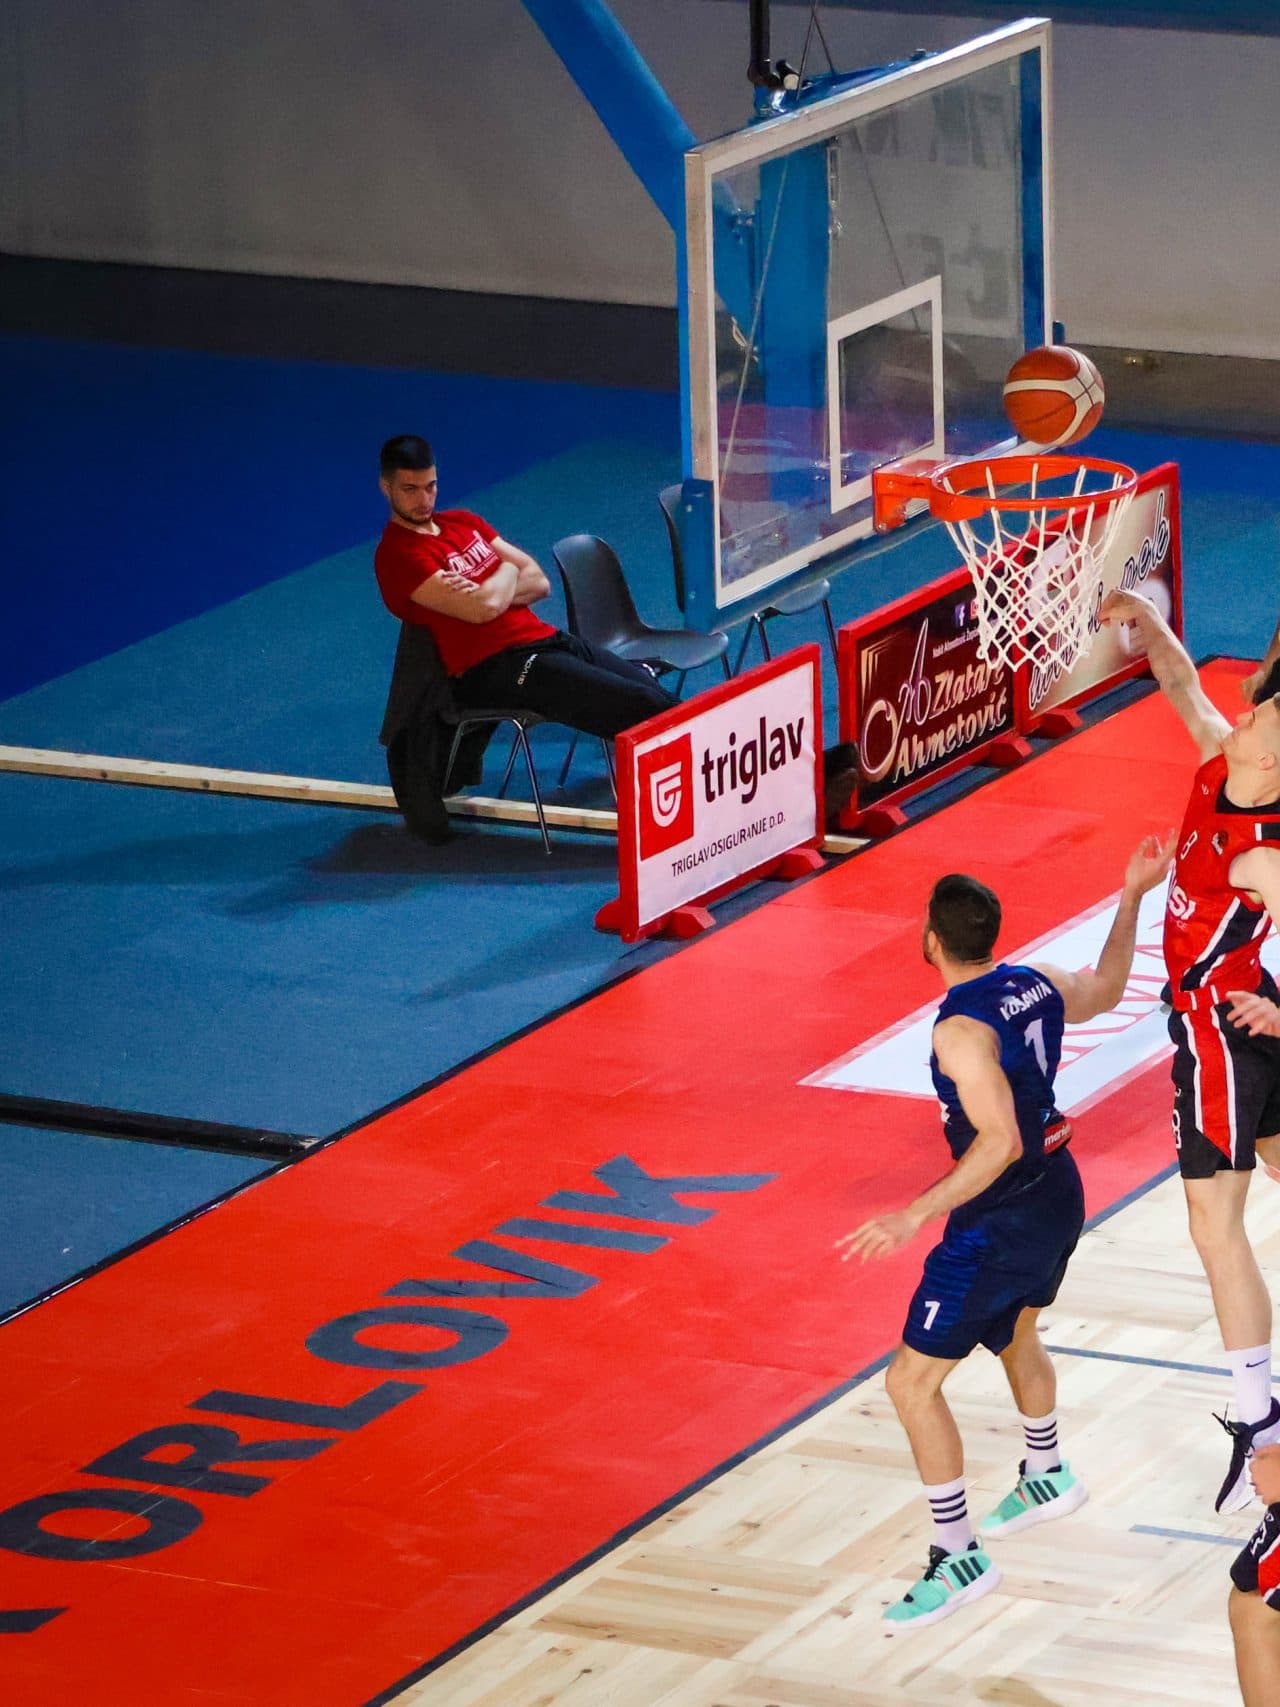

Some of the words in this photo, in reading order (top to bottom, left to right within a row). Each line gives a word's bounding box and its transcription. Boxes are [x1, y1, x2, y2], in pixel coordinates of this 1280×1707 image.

[701, 716, 804, 804] triglav
[893, 687, 1006, 783] Ahmetović
[1024, 1018, 1048, 1077] 1
[0, 1153, 780, 1561] ORLOVIK
[923, 1301, 940, 1331] 7
